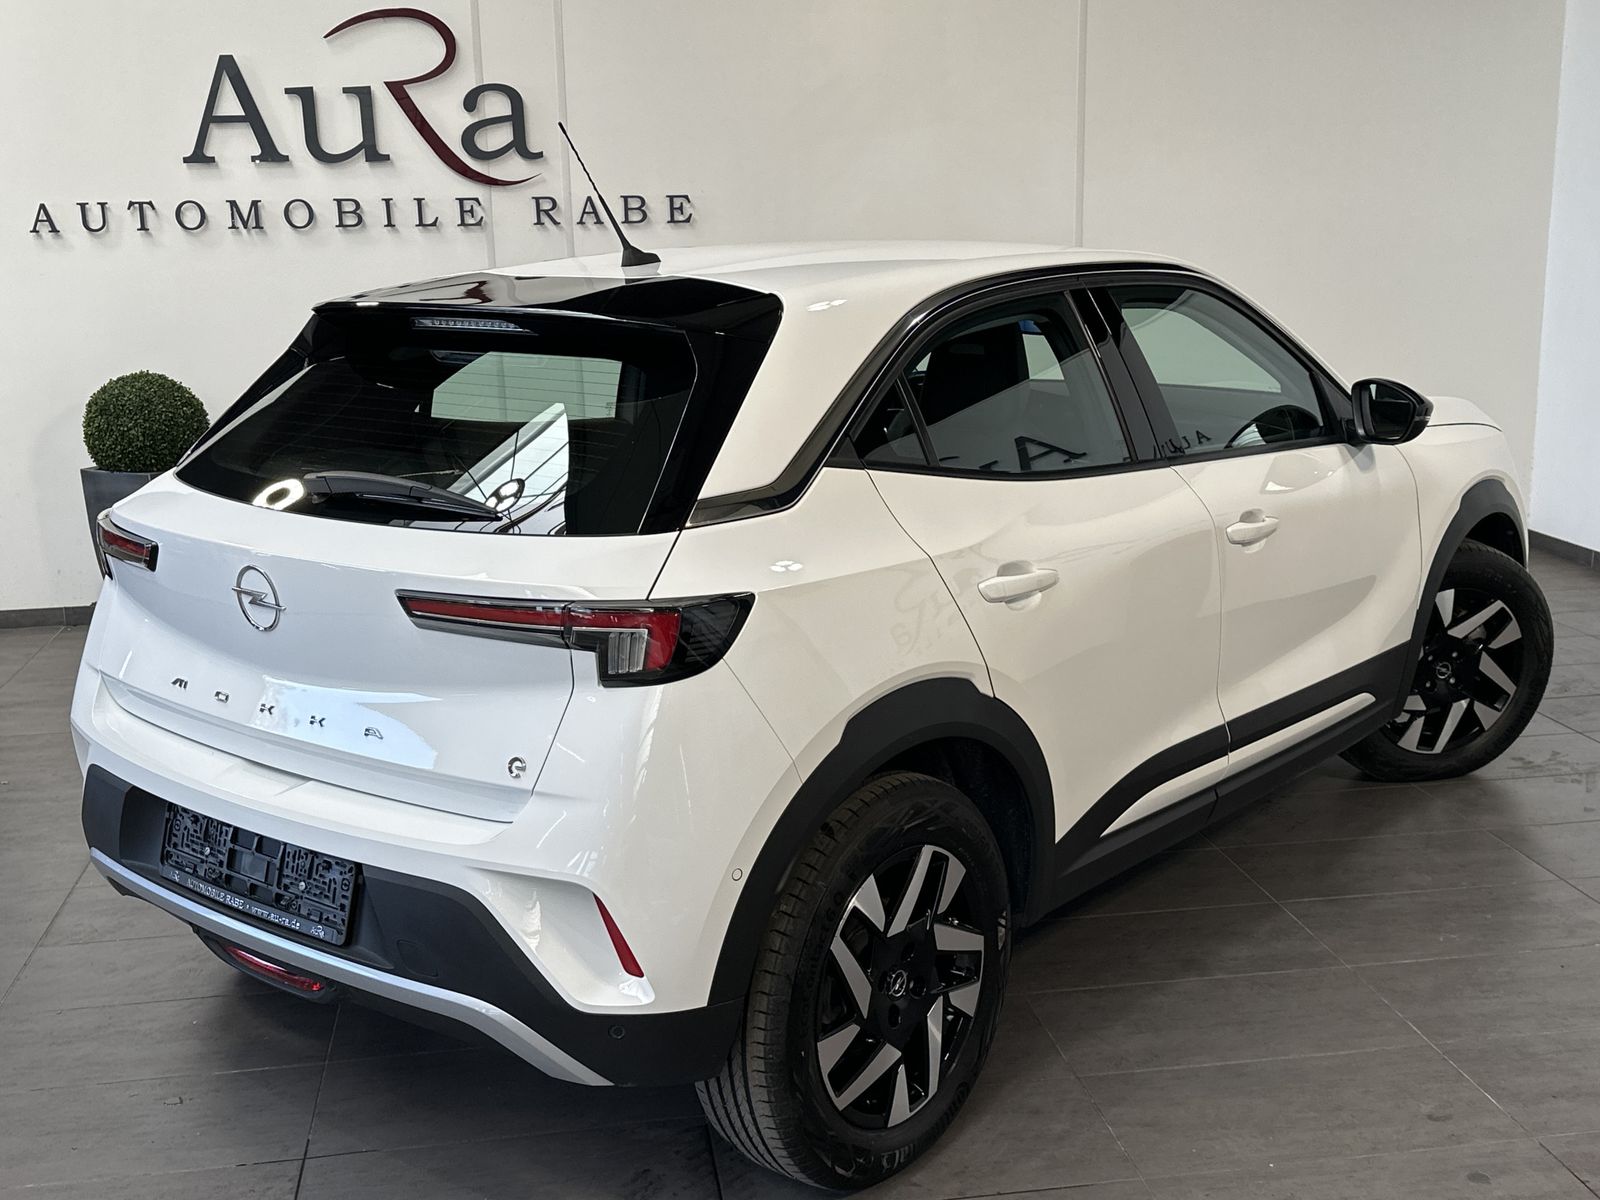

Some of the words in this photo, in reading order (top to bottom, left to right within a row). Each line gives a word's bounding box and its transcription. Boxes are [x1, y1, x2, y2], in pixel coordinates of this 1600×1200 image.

[182, 7, 544, 186] AuRa
[29, 195, 485, 234] AUTOMOBILE
[531, 194, 693, 226] RABE
[171, 675, 384, 741] MOKKA
[186, 878, 225, 903] AUTOMOBILE
[225, 894, 245, 910] RABE
